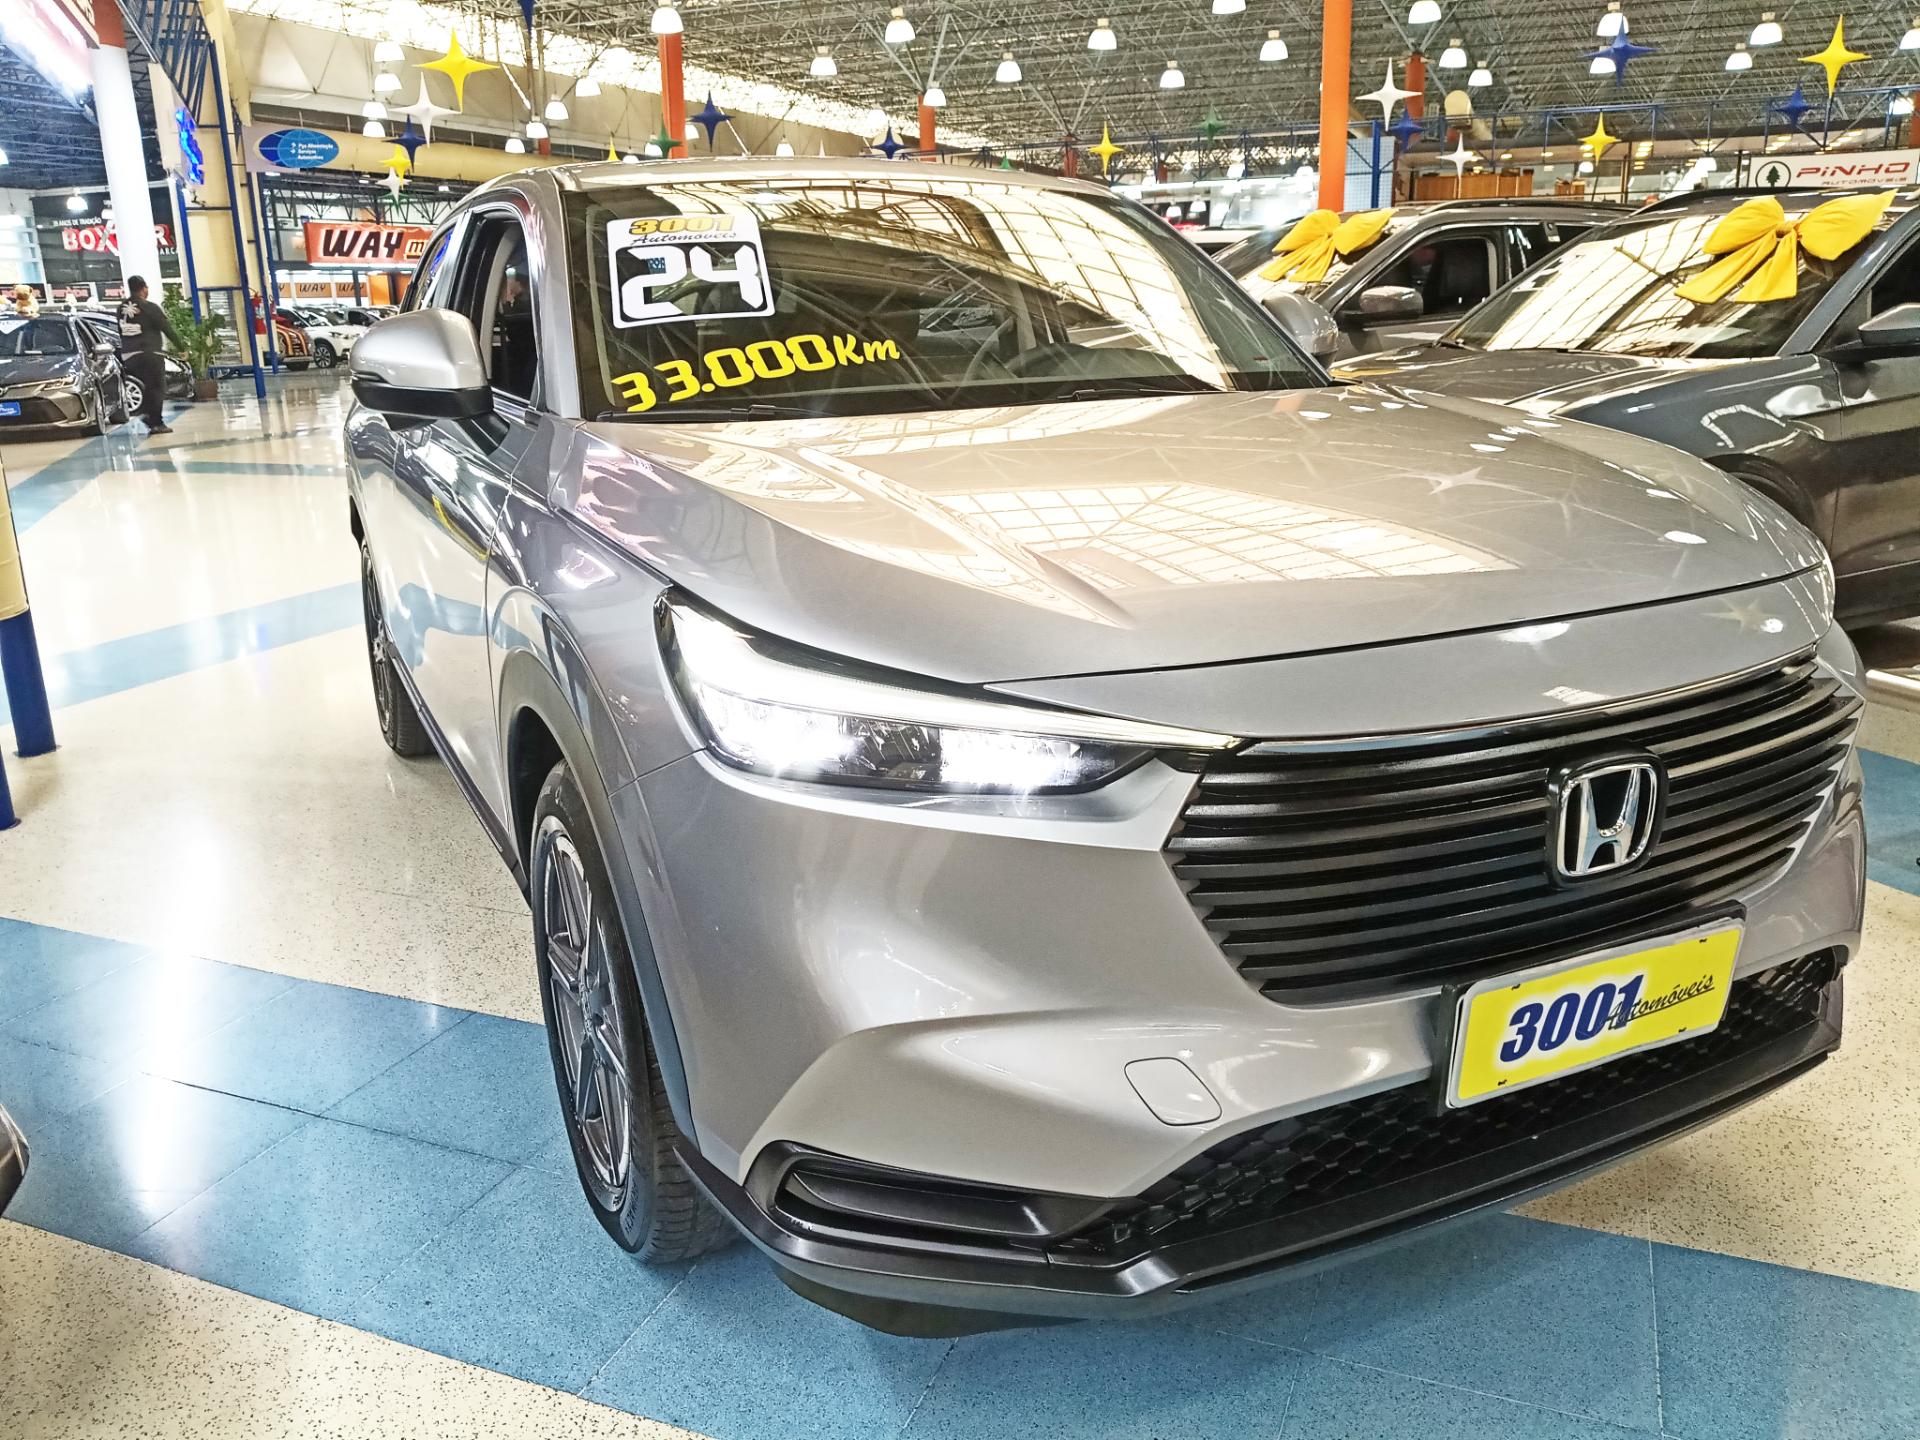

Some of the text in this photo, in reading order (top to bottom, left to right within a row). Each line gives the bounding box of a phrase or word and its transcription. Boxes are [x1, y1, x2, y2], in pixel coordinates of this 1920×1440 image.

[628, 216, 736, 235] 3001
[322, 229, 404, 258] WAY
[299, 282, 326, 293] WAY
[621, 244, 764, 319] 24
[1499, 974, 1645, 1063] 3001
